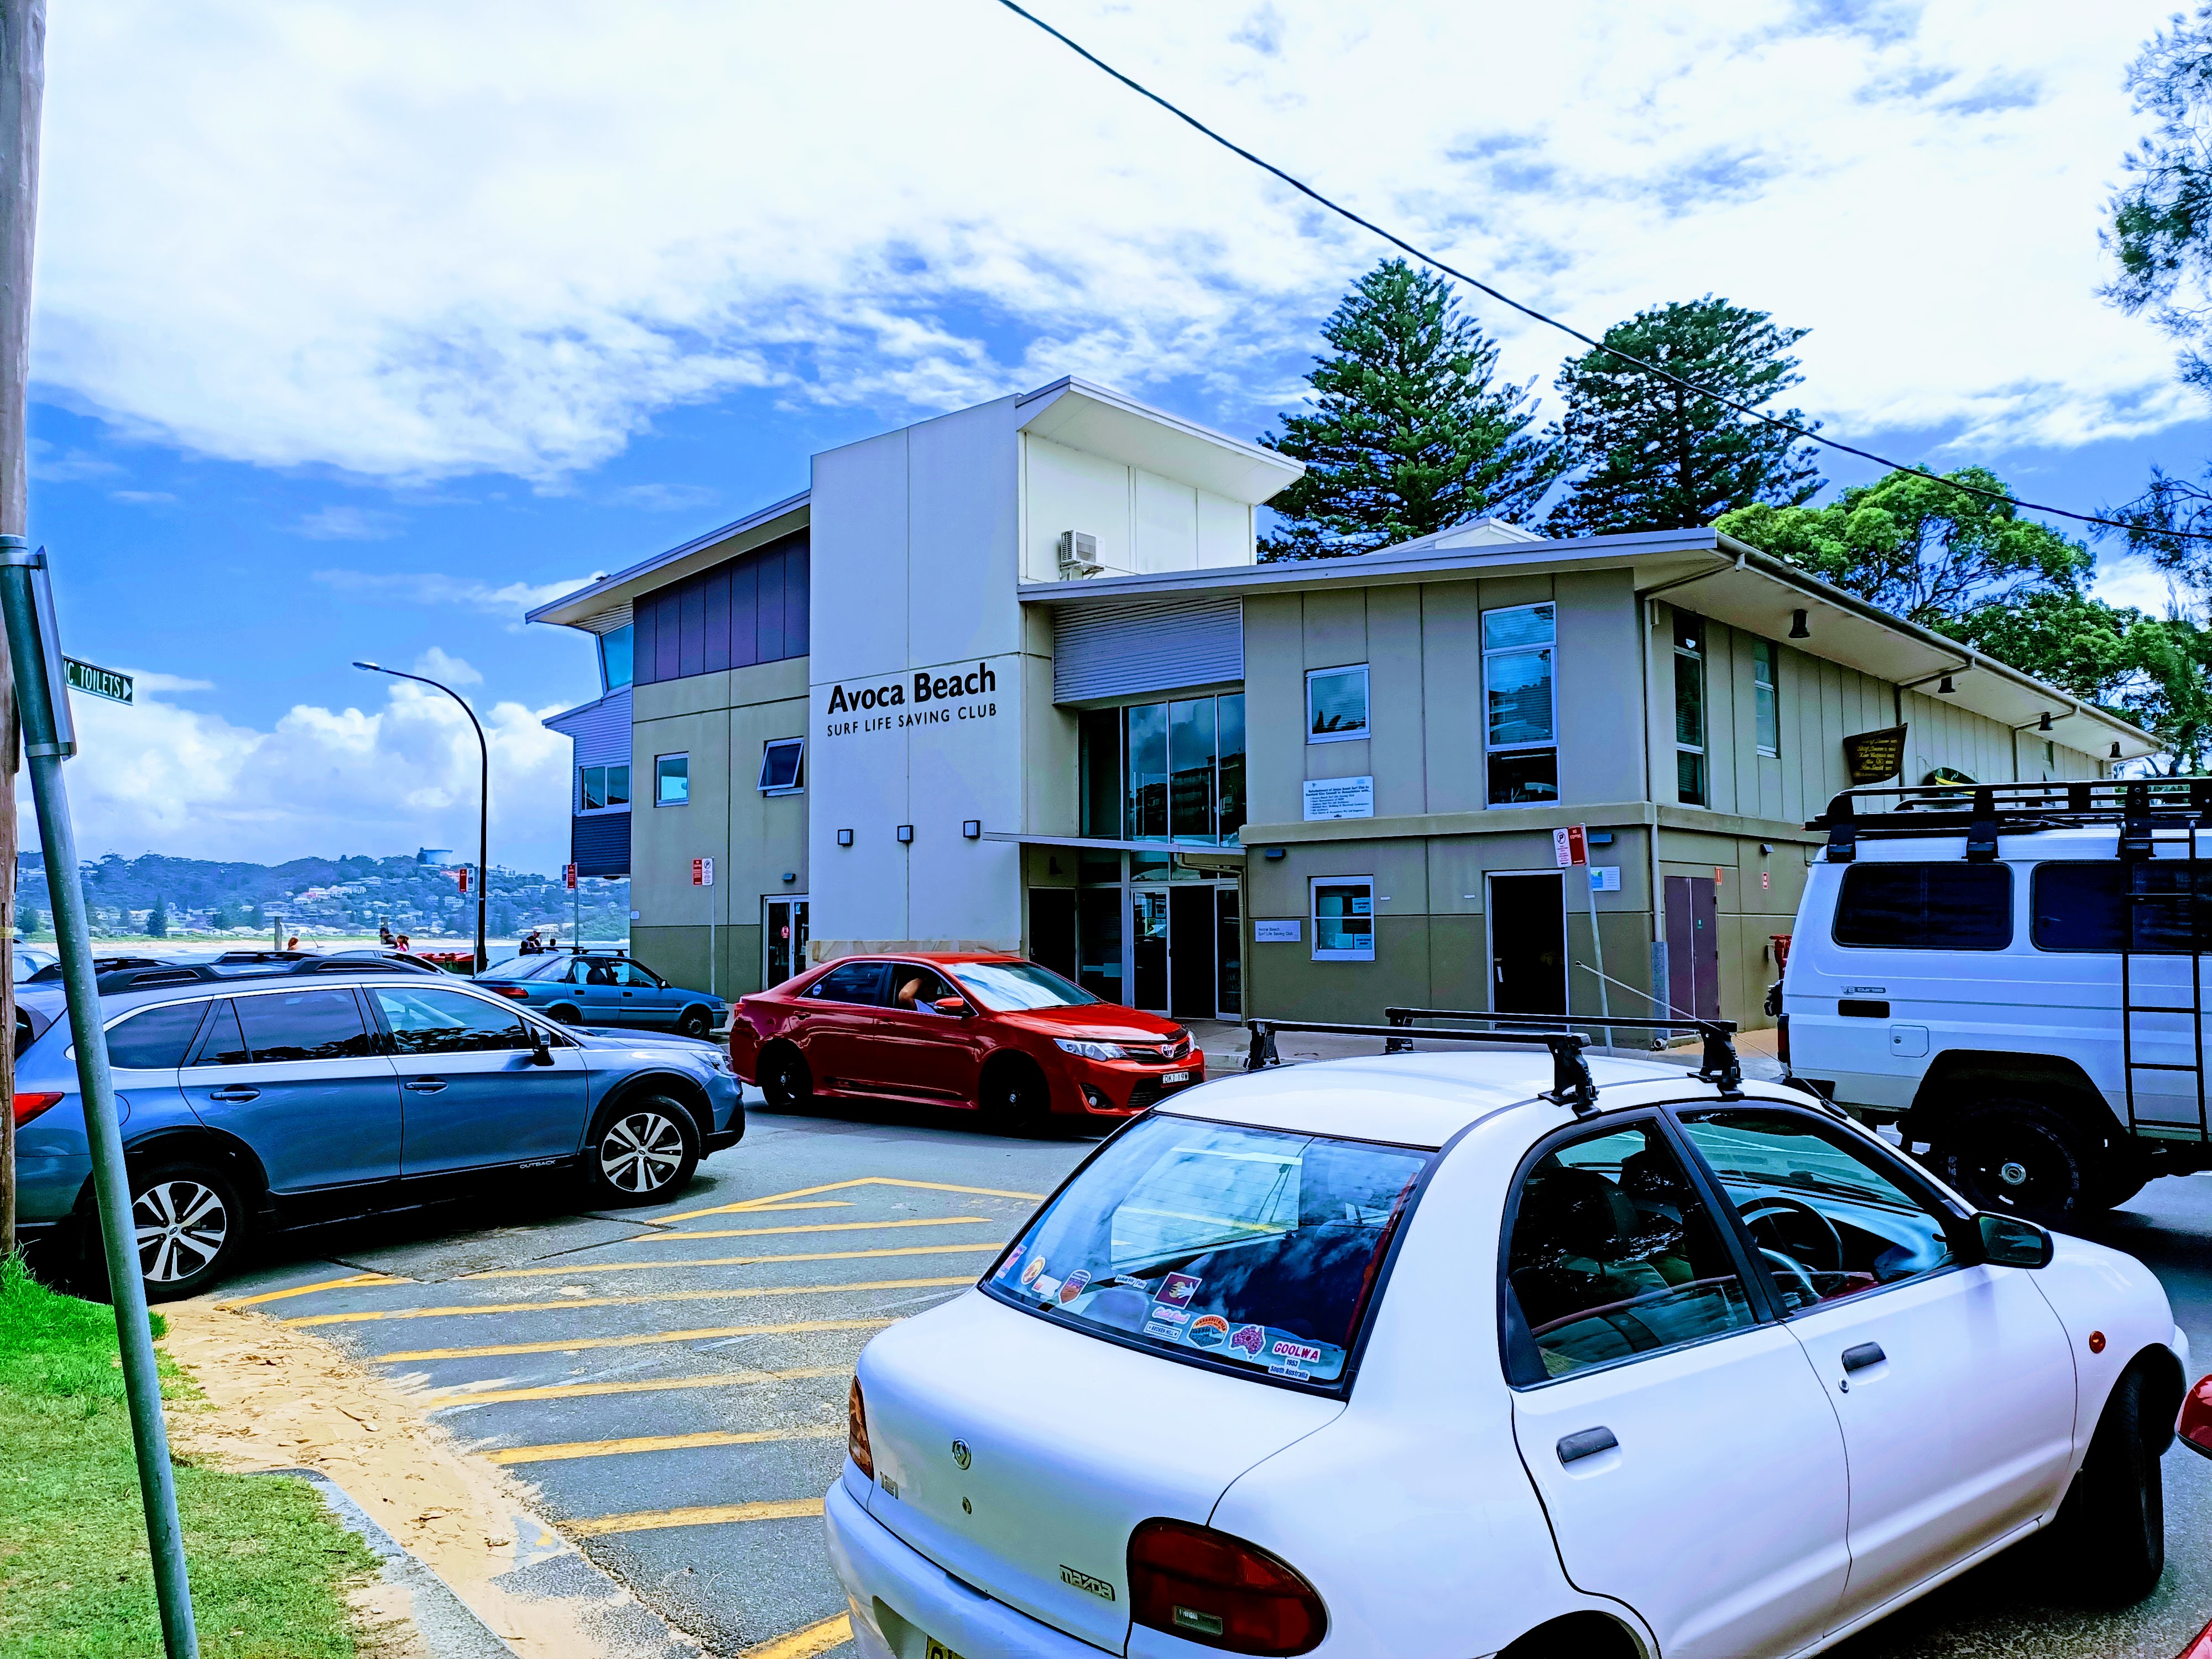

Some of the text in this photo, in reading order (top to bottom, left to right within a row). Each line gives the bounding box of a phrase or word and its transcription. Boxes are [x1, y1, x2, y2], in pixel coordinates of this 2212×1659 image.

[80, 665, 121, 697] TOILETS
[827, 662, 995, 714] Avoca Beach
[827, 703, 997, 737] SURF LIFE SAVING CLUB
[520, 1160, 556, 1168] OUTBACK
[1151, 1326, 1166, 1334] BROKEN
[1274, 1343, 1319, 1361] GOOLWA
[1270, 1365, 1308, 1379] South Australia
[1286, 1359, 1298, 1367] 1953
[880, 1471, 899, 1500] 121
